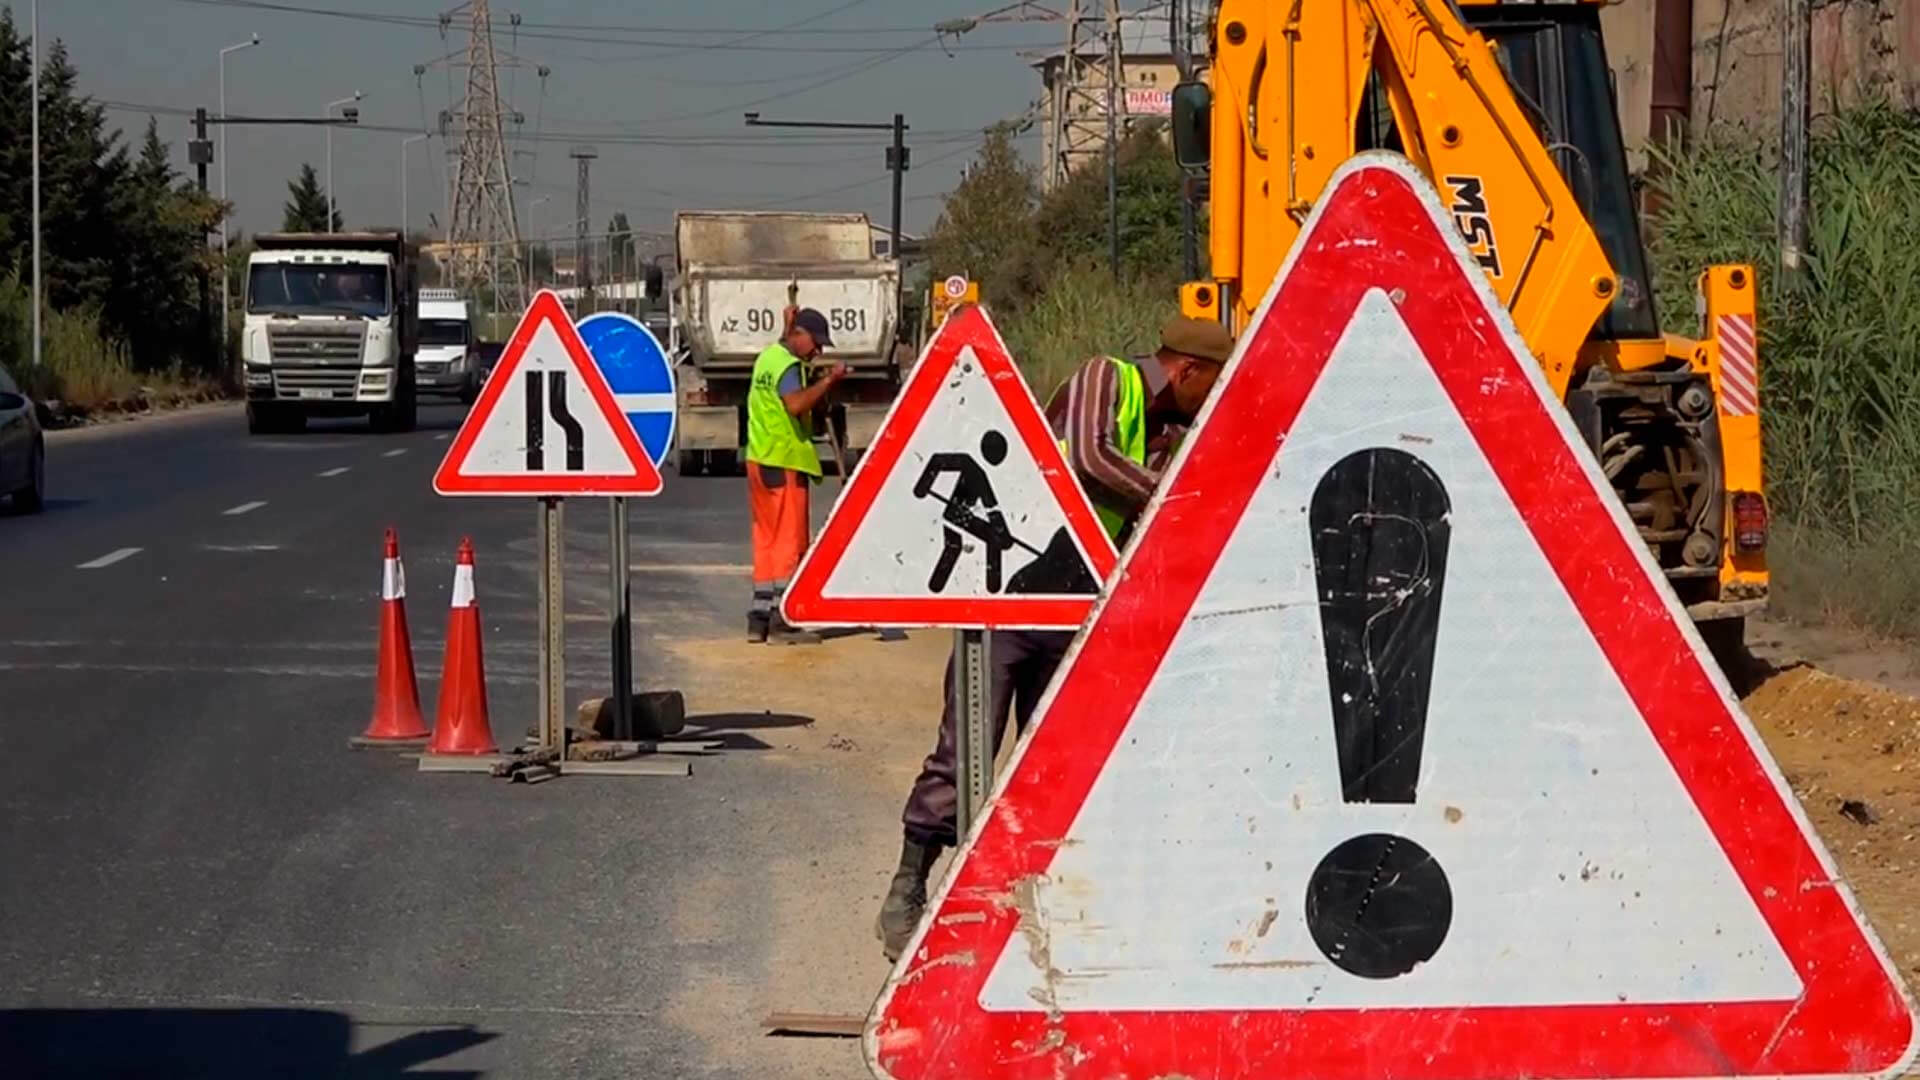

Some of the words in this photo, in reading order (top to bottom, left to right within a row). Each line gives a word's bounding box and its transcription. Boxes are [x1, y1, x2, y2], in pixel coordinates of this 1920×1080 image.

[1445, 175, 1501, 277] MST
[720, 317, 739, 333] AZ
[747, 308, 775, 333] 90
[830, 308, 866, 332] 581
